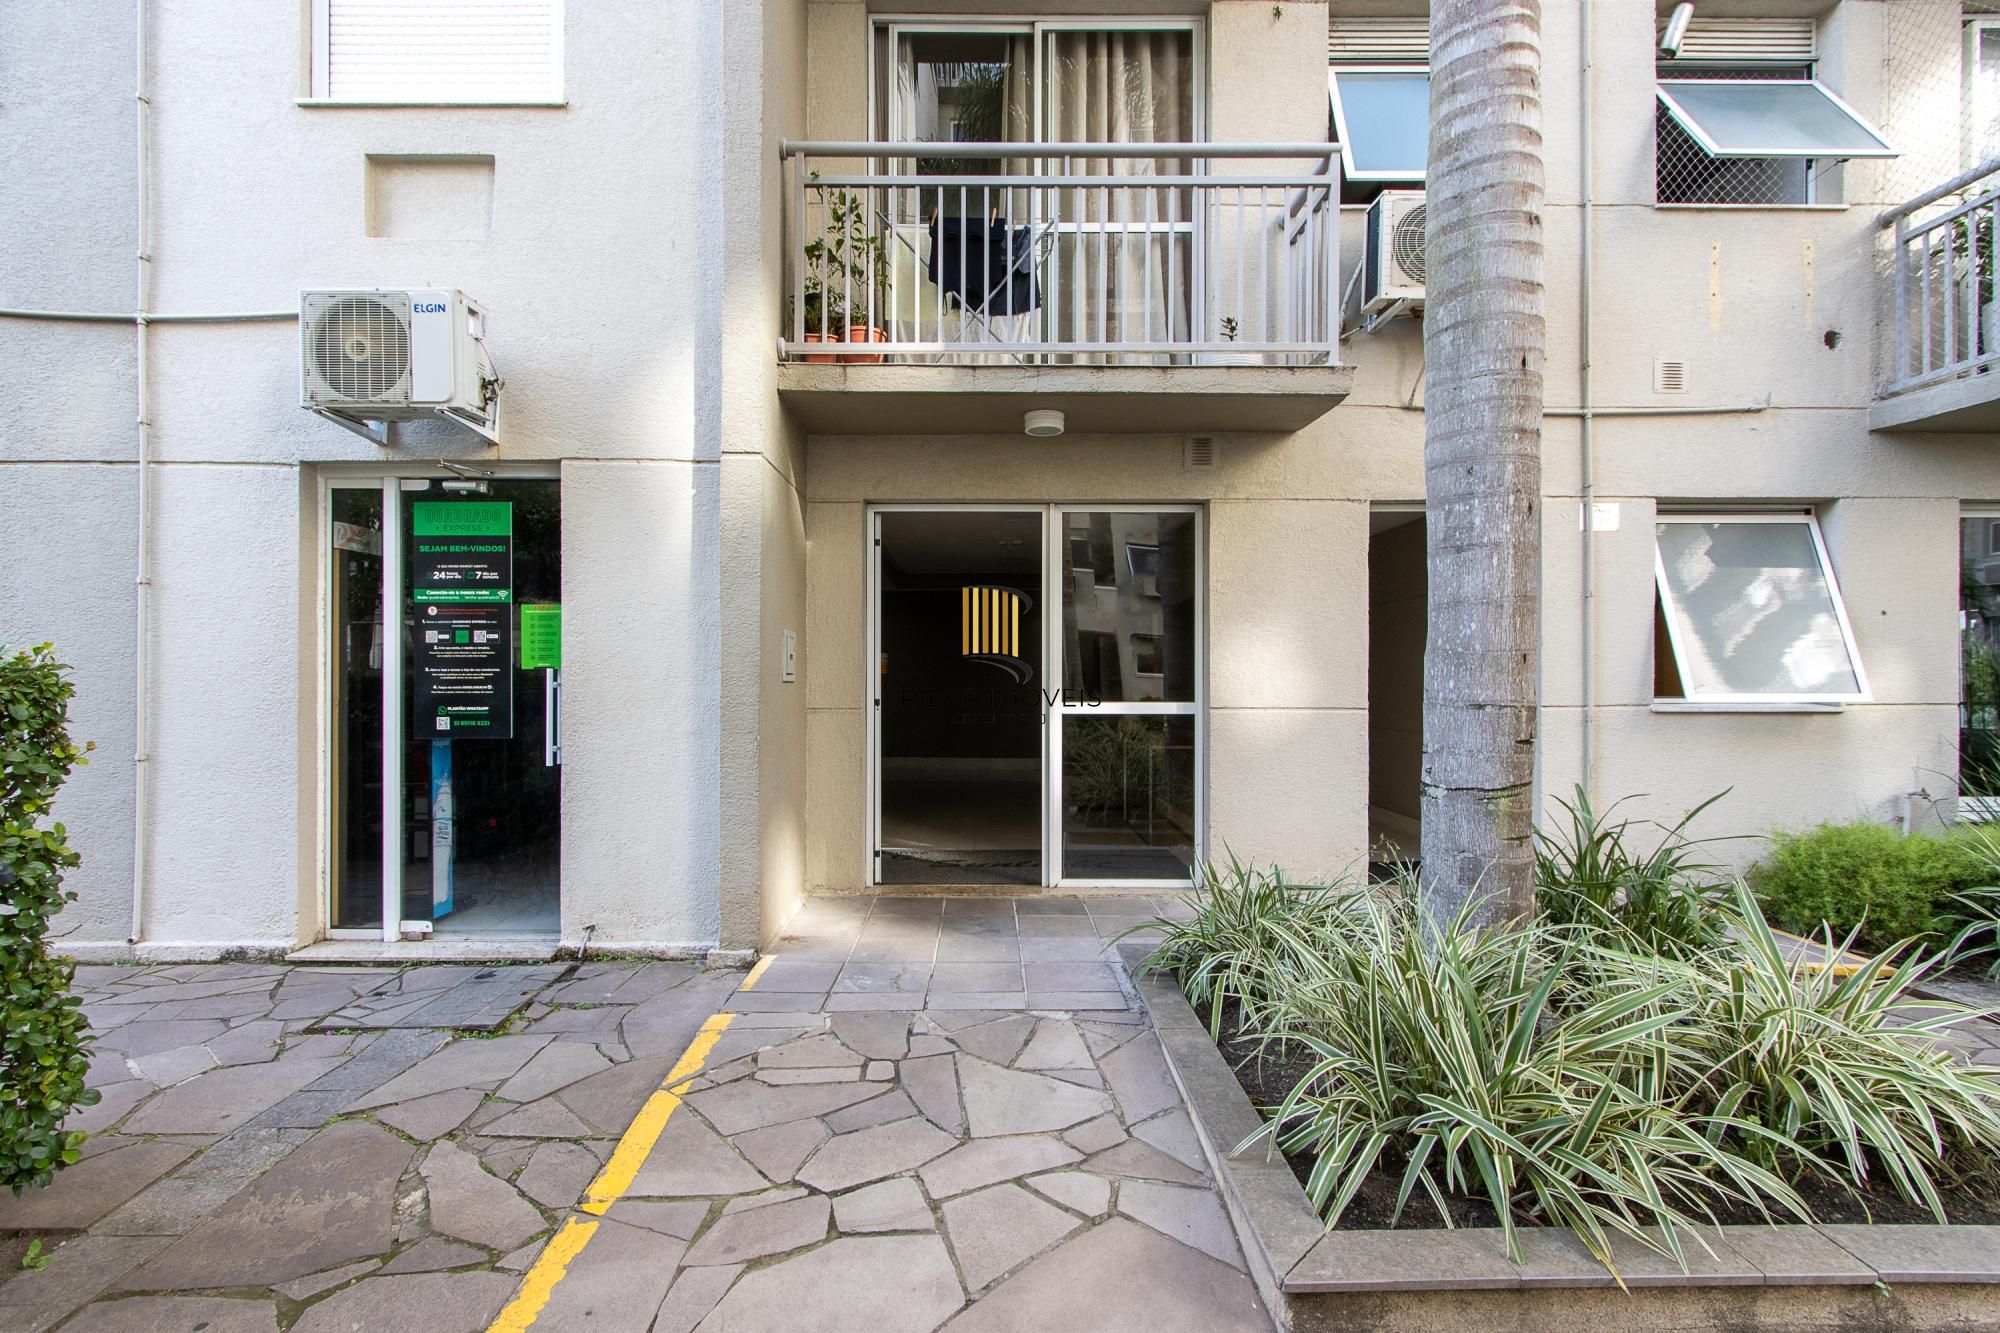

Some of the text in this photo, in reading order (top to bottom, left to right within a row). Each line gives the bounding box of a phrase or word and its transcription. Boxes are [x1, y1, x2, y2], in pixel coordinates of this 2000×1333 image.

[413, 303, 446, 313] ELGIN
[443, 524, 482, 532] EXPRESS
[433, 571, 446, 580] 24
[475, 571, 482, 580] 7
